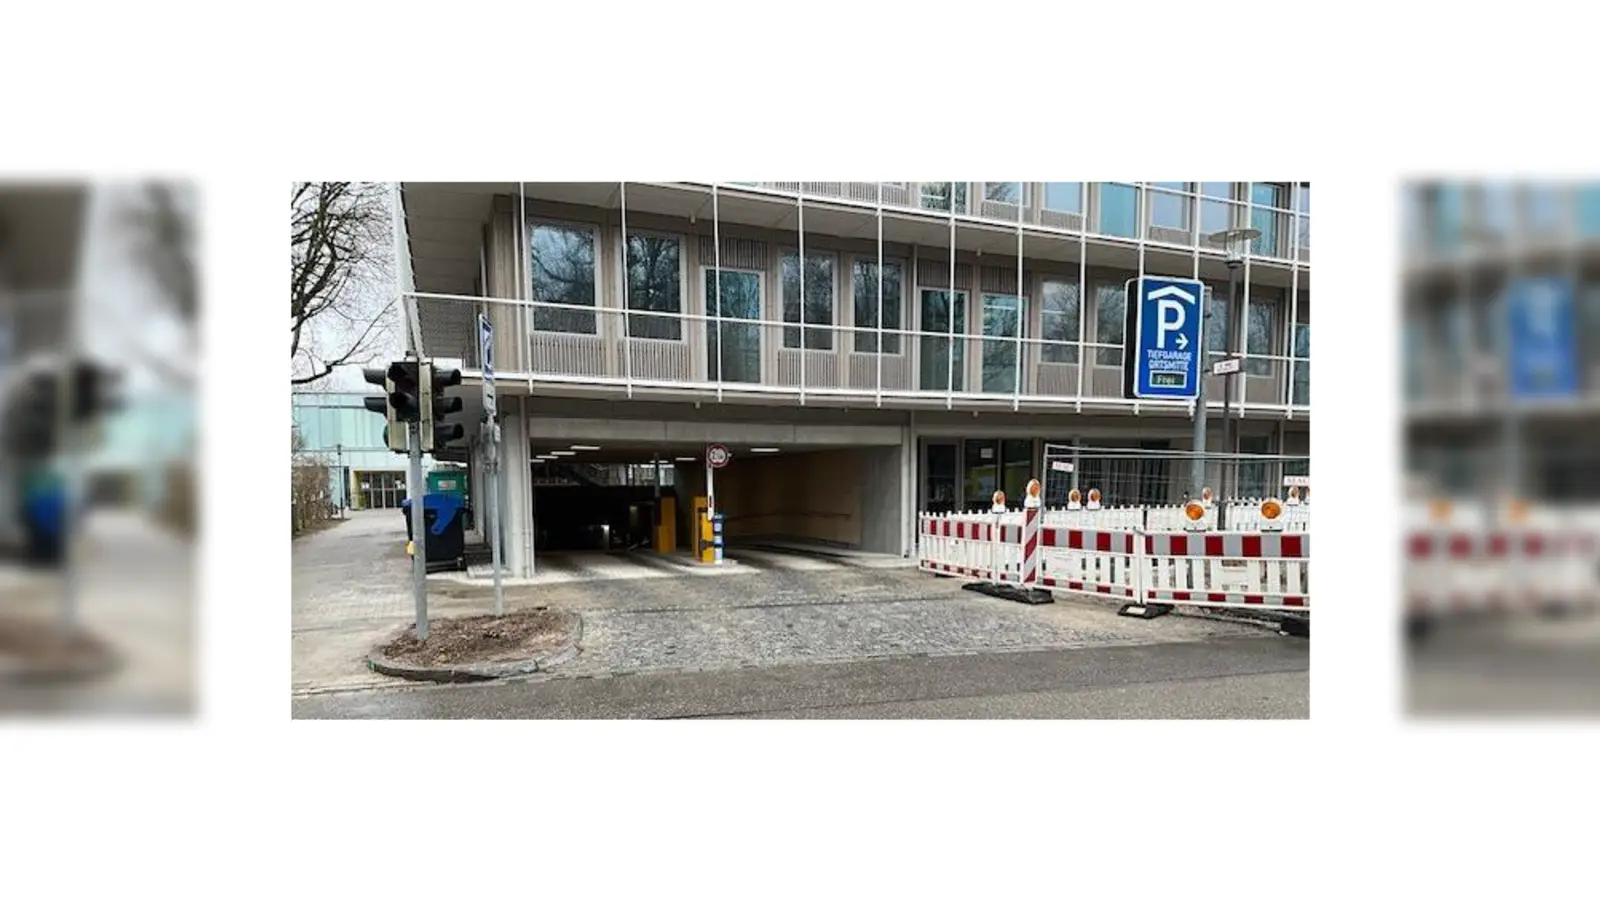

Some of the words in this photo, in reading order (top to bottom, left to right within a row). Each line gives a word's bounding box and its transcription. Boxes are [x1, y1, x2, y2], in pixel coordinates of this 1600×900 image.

[1157, 299, 1185, 349] P
[1147, 349, 1192, 361] TIEFGARAGE
[1148, 360, 1189, 371] ORTSMITTE
